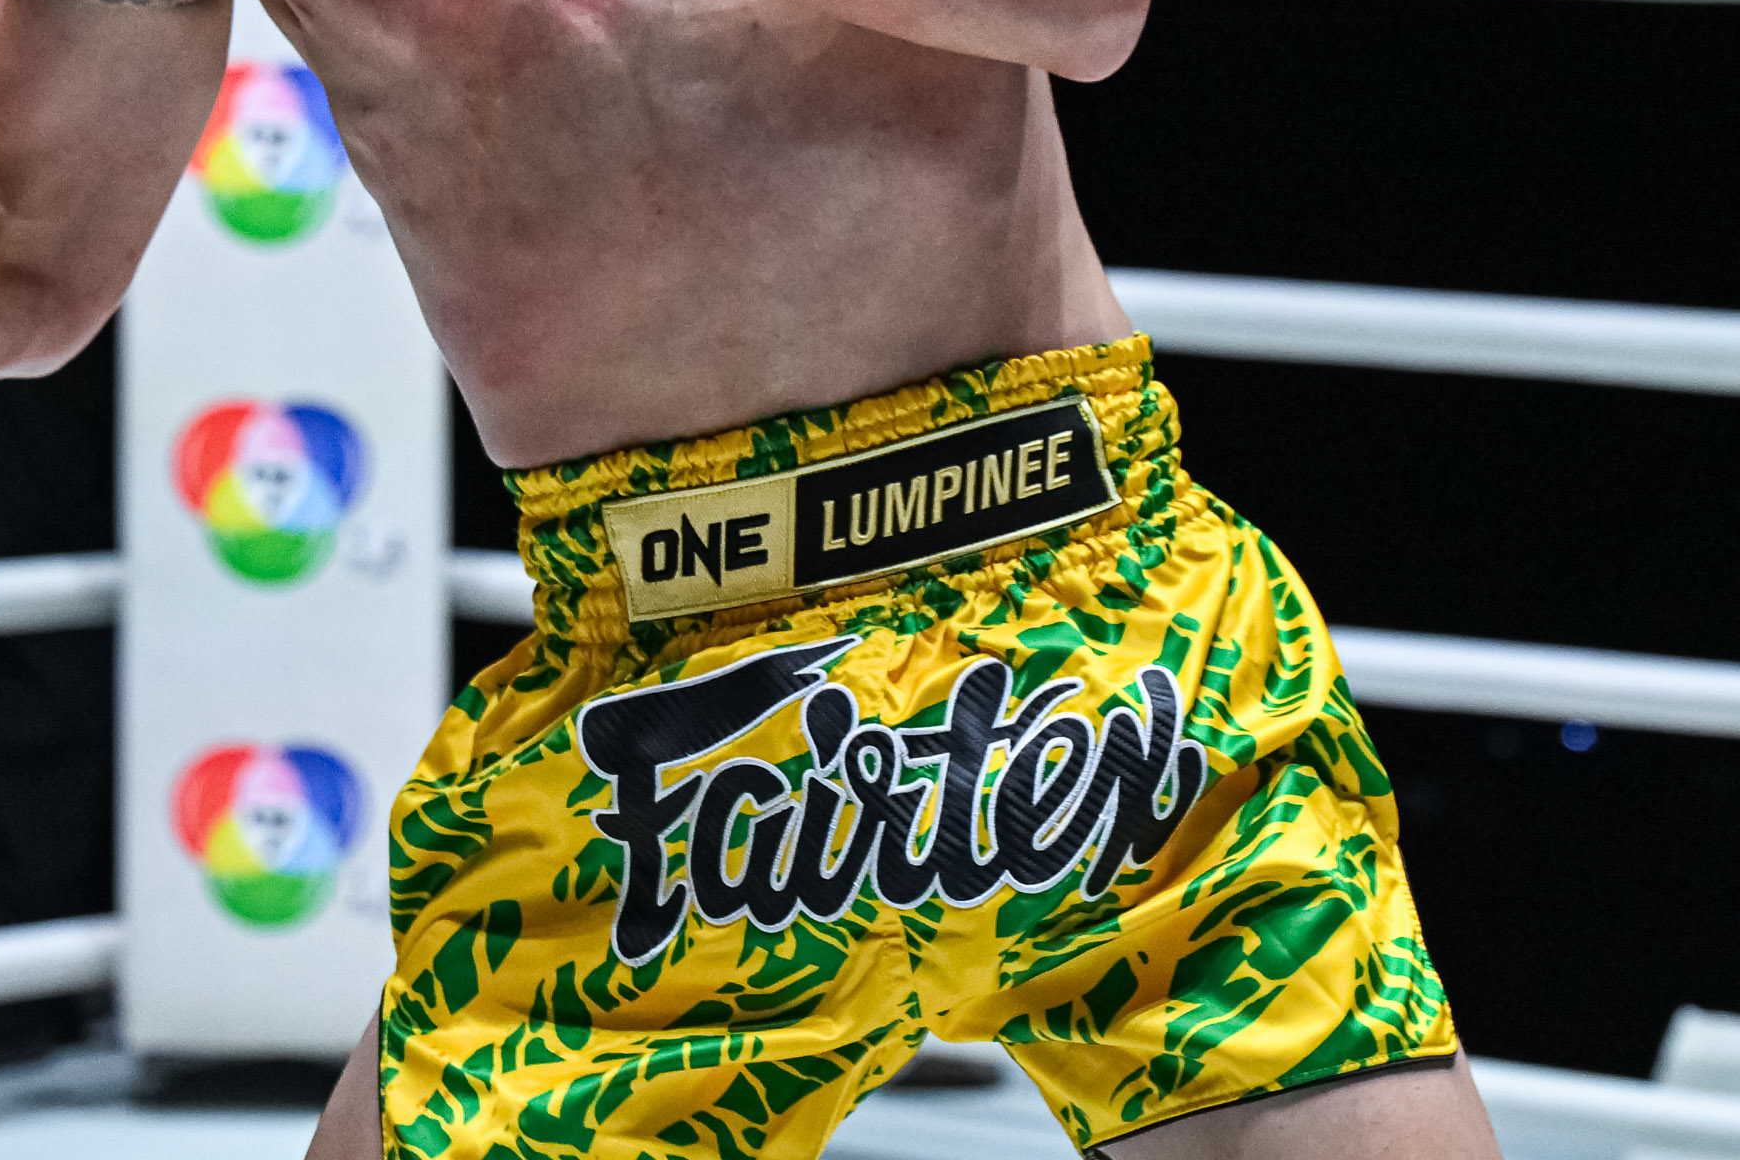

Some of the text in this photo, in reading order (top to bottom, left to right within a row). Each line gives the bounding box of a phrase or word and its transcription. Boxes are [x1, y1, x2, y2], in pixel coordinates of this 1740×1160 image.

[641, 430, 1073, 587] ONE LUMPINEE
[577, 635, 1208, 966] Fairtex
